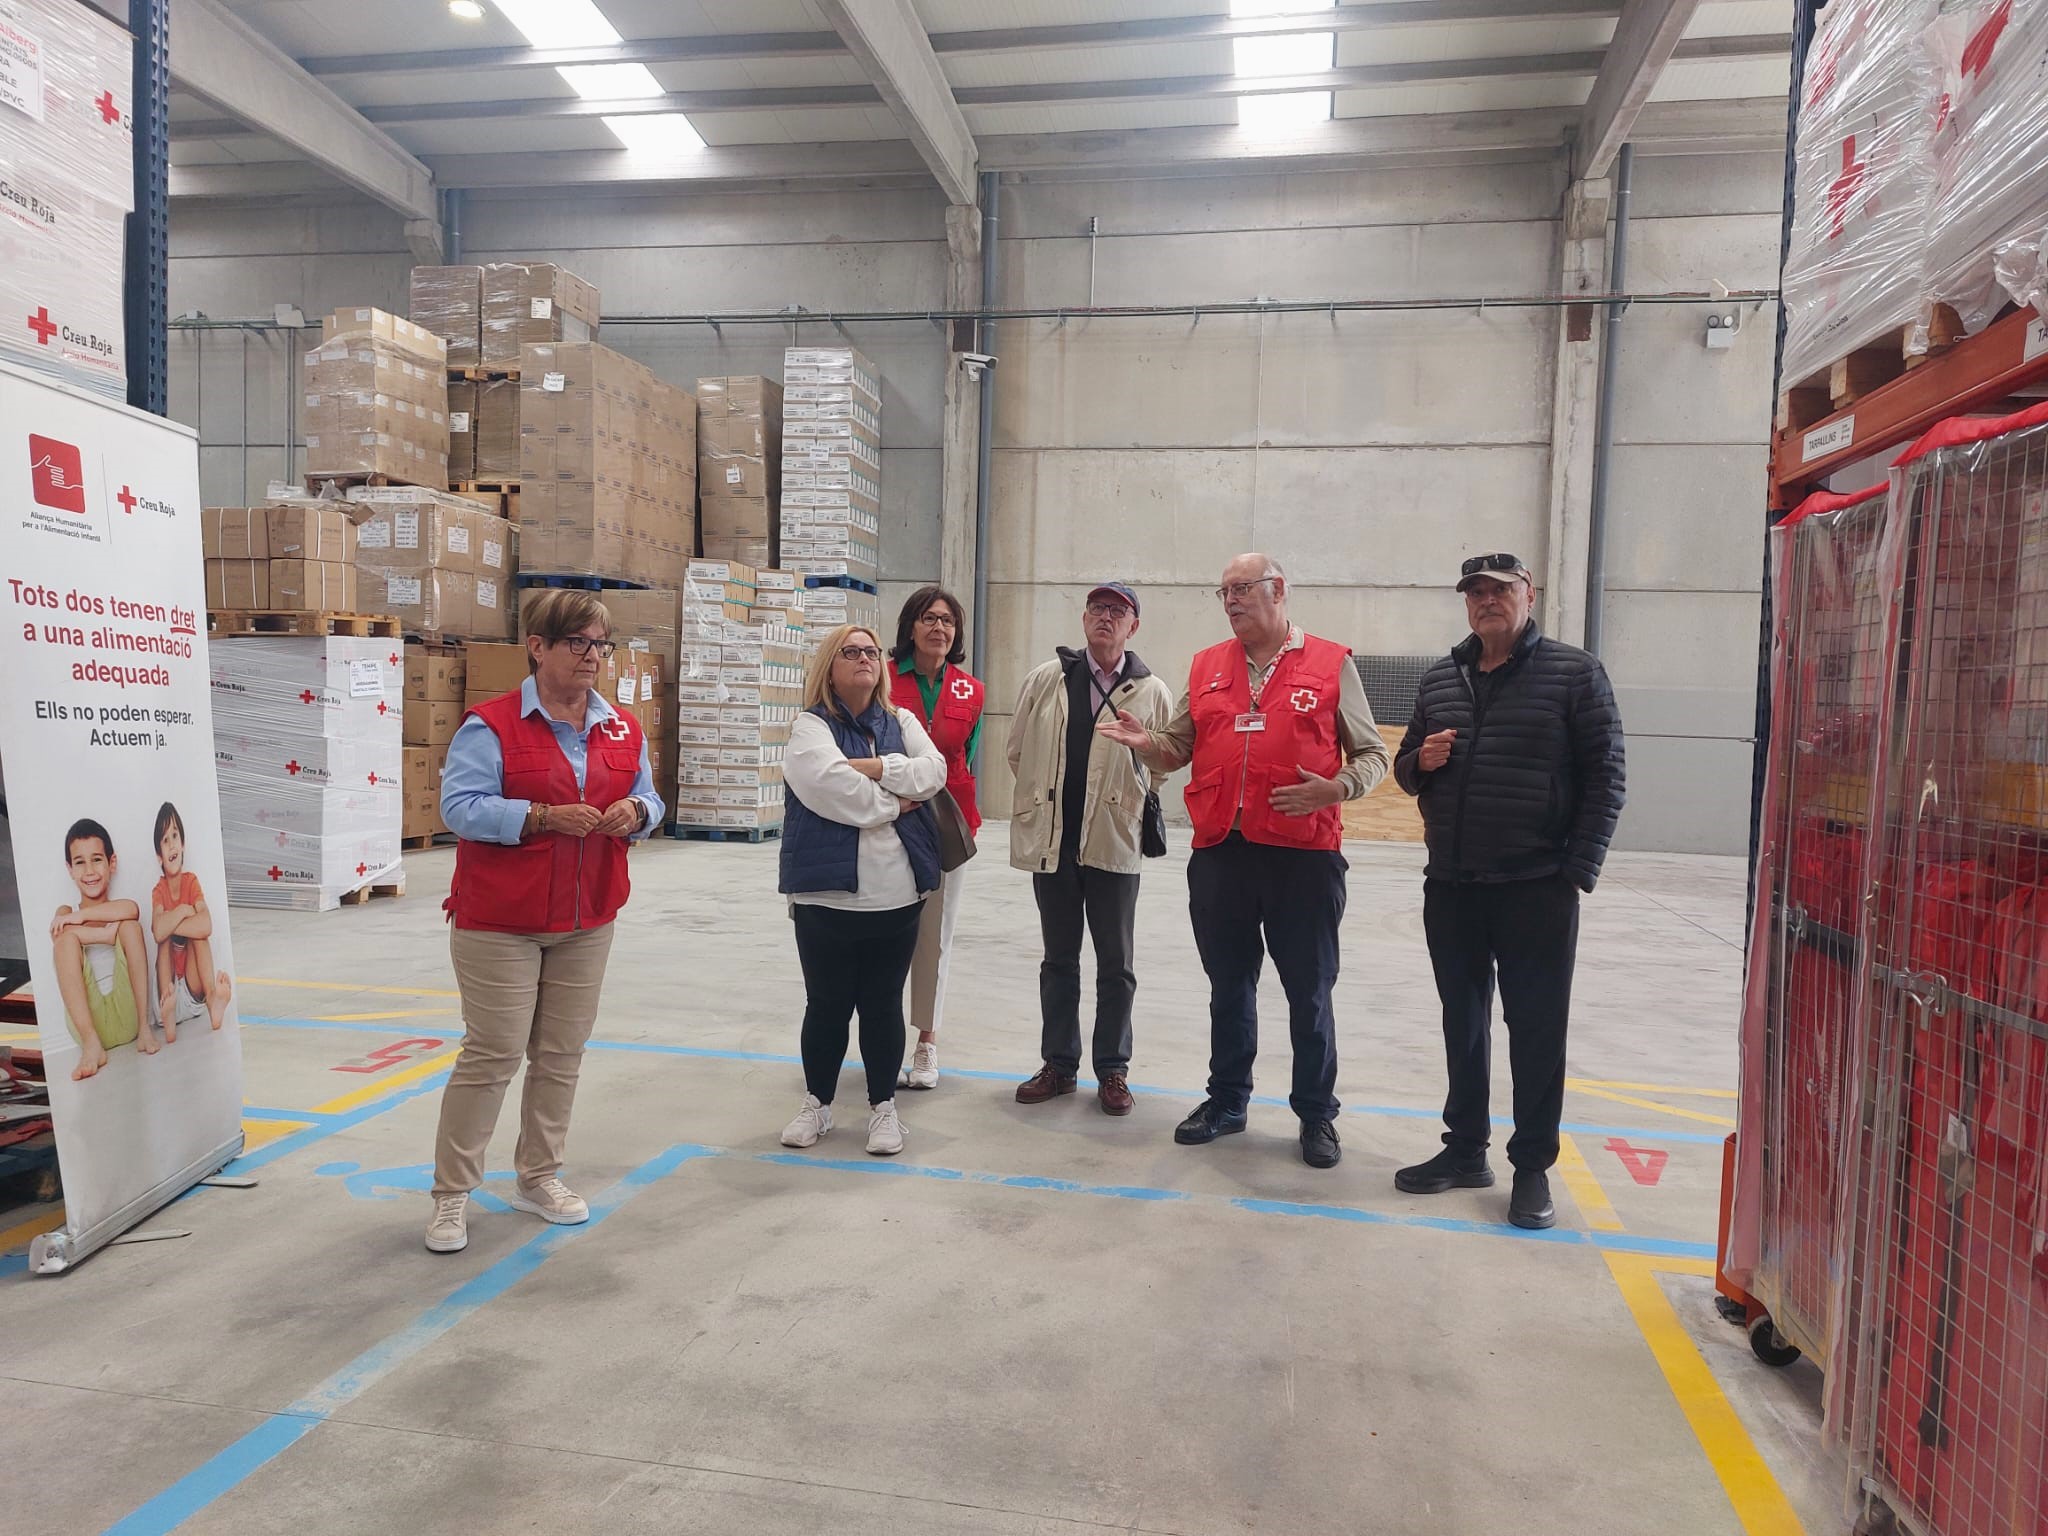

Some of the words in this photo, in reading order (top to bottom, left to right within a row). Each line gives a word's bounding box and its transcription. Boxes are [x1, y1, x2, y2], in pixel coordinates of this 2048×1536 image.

[0, 180, 27, 208] Creu
[31, 196, 55, 223] Roja
[62, 325, 87, 346] Creu
[90, 334, 112, 356] Roja
[30, 511, 54, 523] Aliança
[55, 516, 92, 531] Humanitària
[139, 497, 158, 512] Creu
[159, 501, 176, 517] Roja
[8, 578, 59, 609] Tots
[65, 589, 105, 615] dos
[110, 596, 166, 623] tenen
[170, 605, 196, 629] dret
[23, 622, 37, 642] a
[44, 624, 84, 647] una
[91, 627, 192, 659] alimentació
[72, 659, 170, 689] adequada
[35, 700, 68, 720] Ells
[73, 706, 94, 721] no
[100, 704, 150, 725] poden
[154, 709, 194, 726] esperar.
[90, 728, 151, 746] Actuem
[155, 730, 167, 750] ja.
[328, 1039, 444, 1073] 5
[1603, 1137, 1669, 1186] 4
